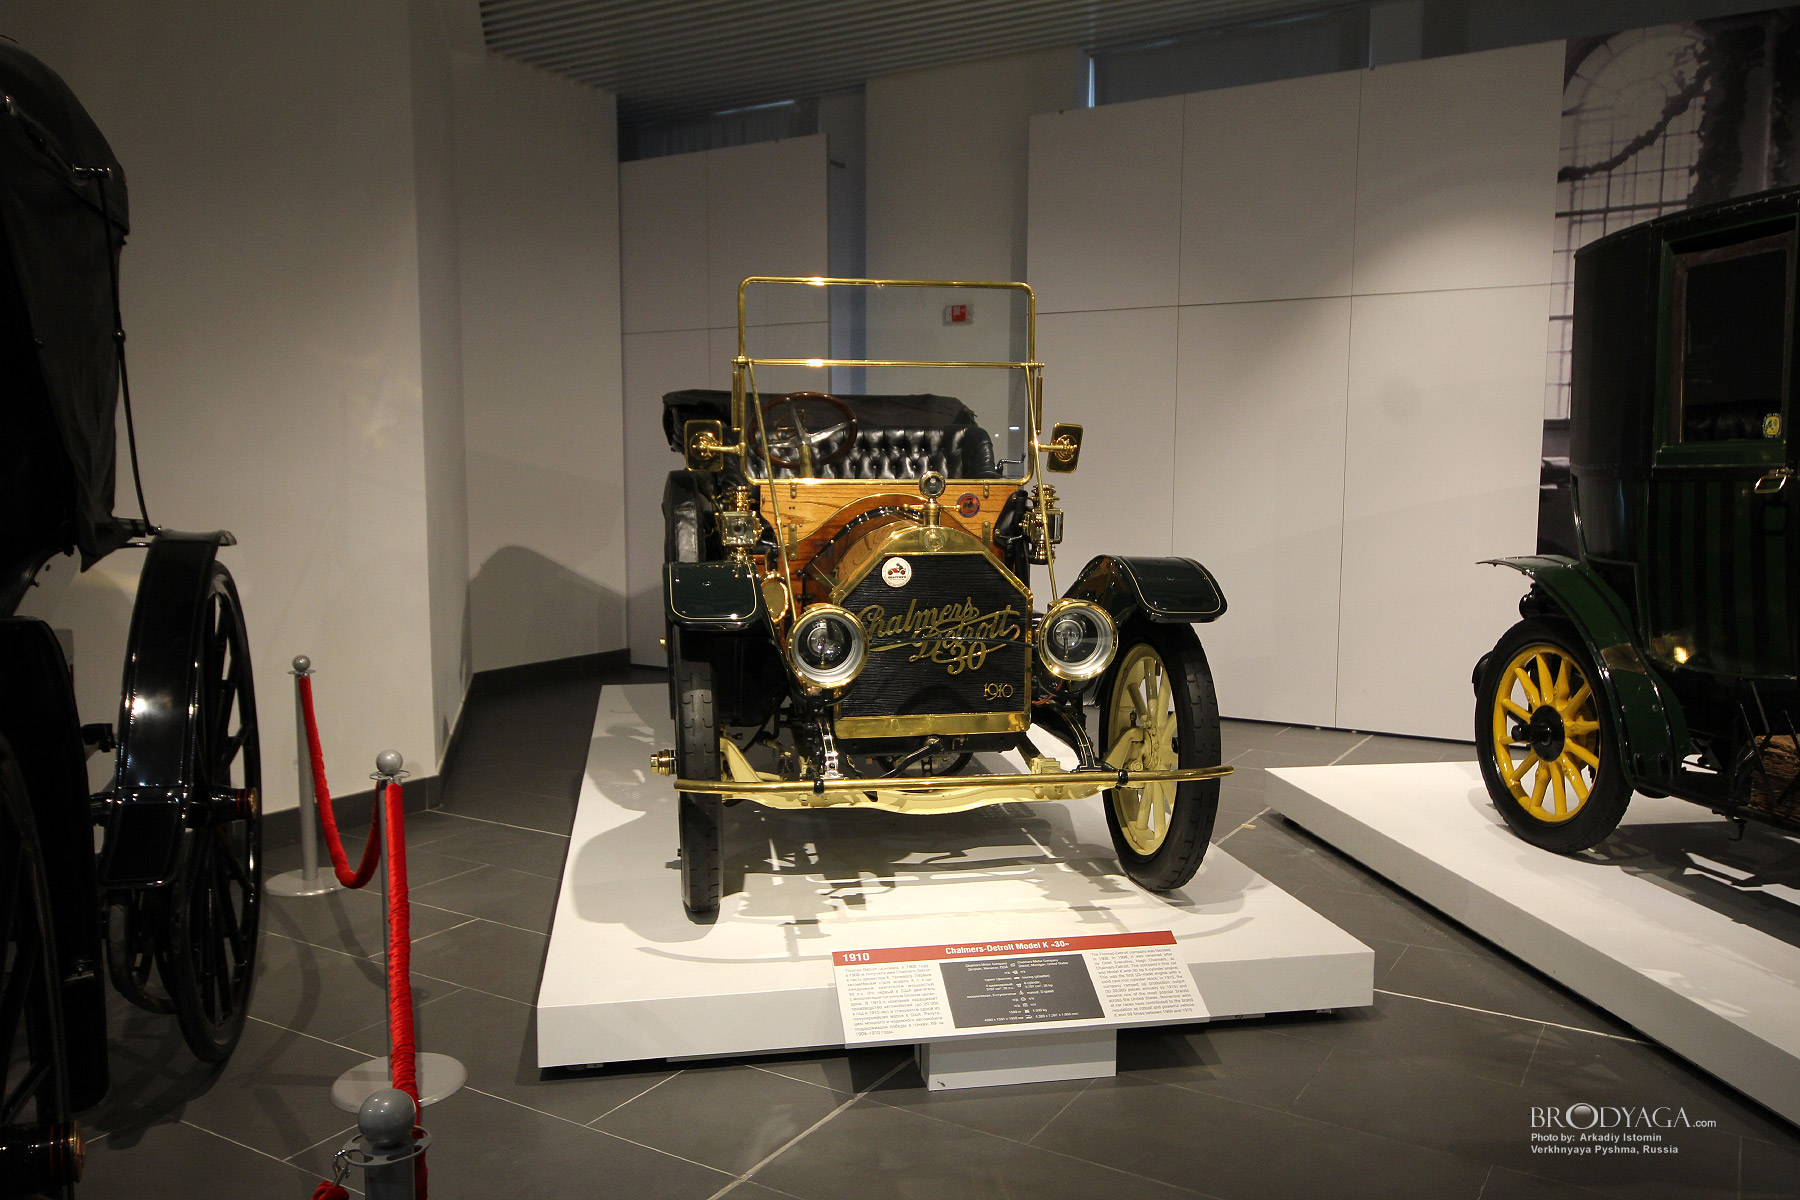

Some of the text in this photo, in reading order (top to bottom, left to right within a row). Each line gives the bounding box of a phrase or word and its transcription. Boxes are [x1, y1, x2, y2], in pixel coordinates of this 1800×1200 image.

[947, 641, 987, 675] 30
[983, 682, 1014, 700] 1910
[945, 944, 1014, 955] Chalmers-Detroit
[1016, 942, 1041, 950] Model
[842, 952, 871, 962] 1910
